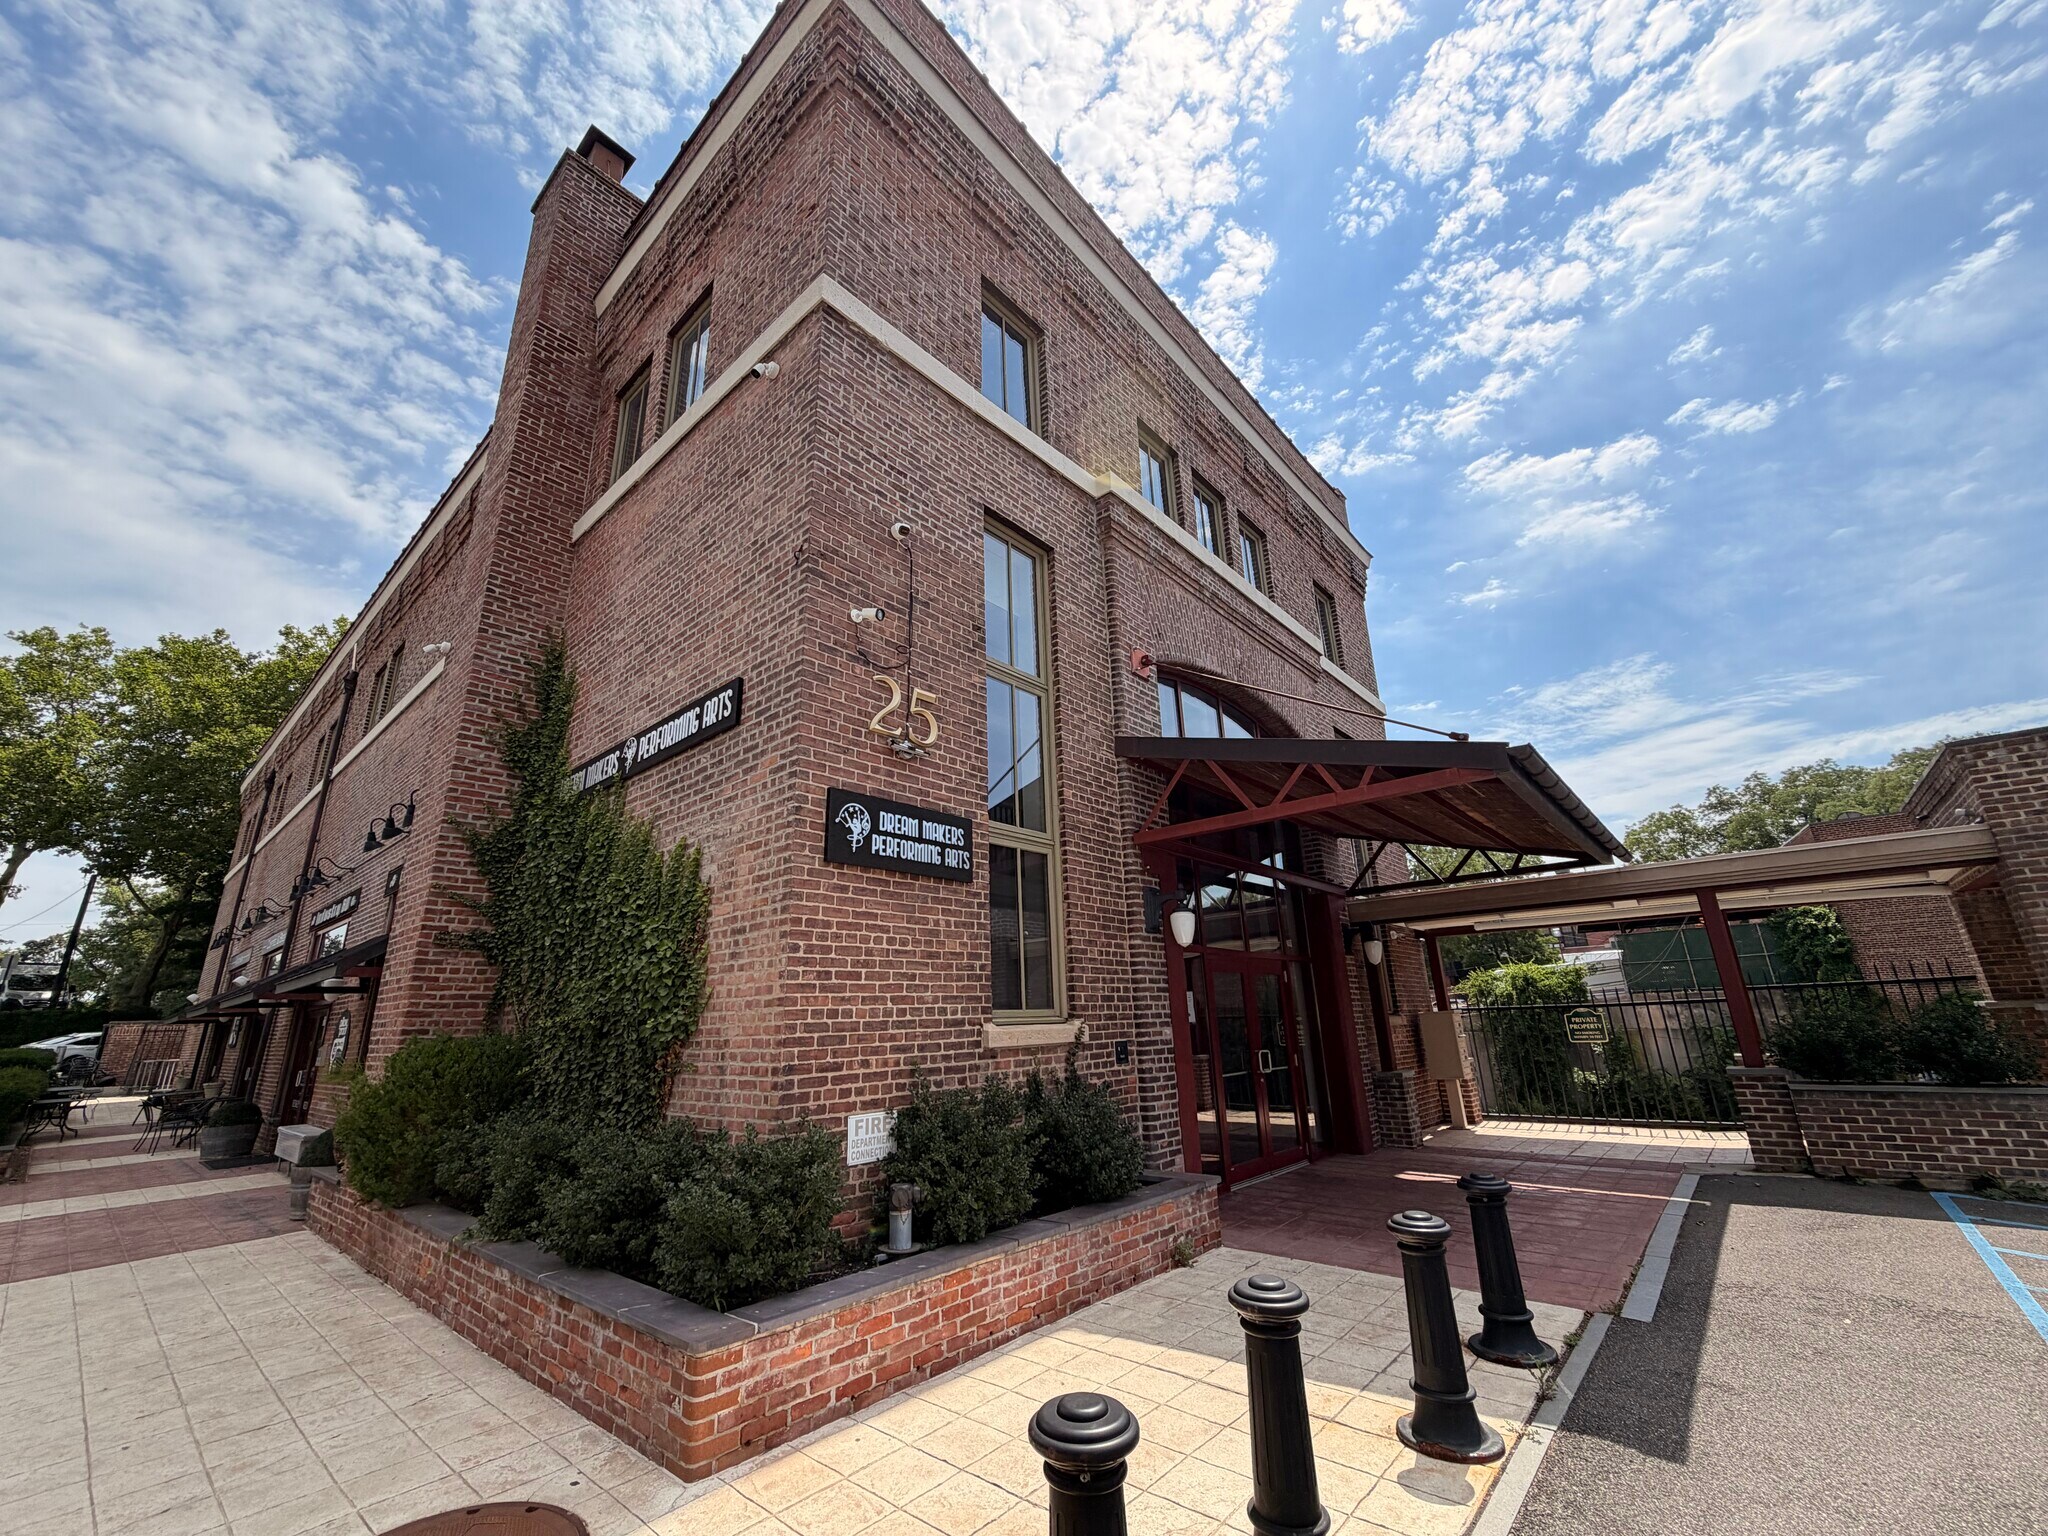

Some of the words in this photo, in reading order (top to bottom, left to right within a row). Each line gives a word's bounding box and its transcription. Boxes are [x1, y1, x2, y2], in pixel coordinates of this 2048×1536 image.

[868, 675, 939, 748] 25
[585, 751, 620, 789] MAKERS
[637, 706, 701, 763] PERFORMING
[701, 688, 733, 730] ARTS
[878, 811, 920, 837] DREAM
[922, 819, 966, 847] MAKERS
[871, 834, 942, 866] PERFORMING
[944, 846, 971, 871] ARTS
[854, 1115, 892, 1137] FIRE
